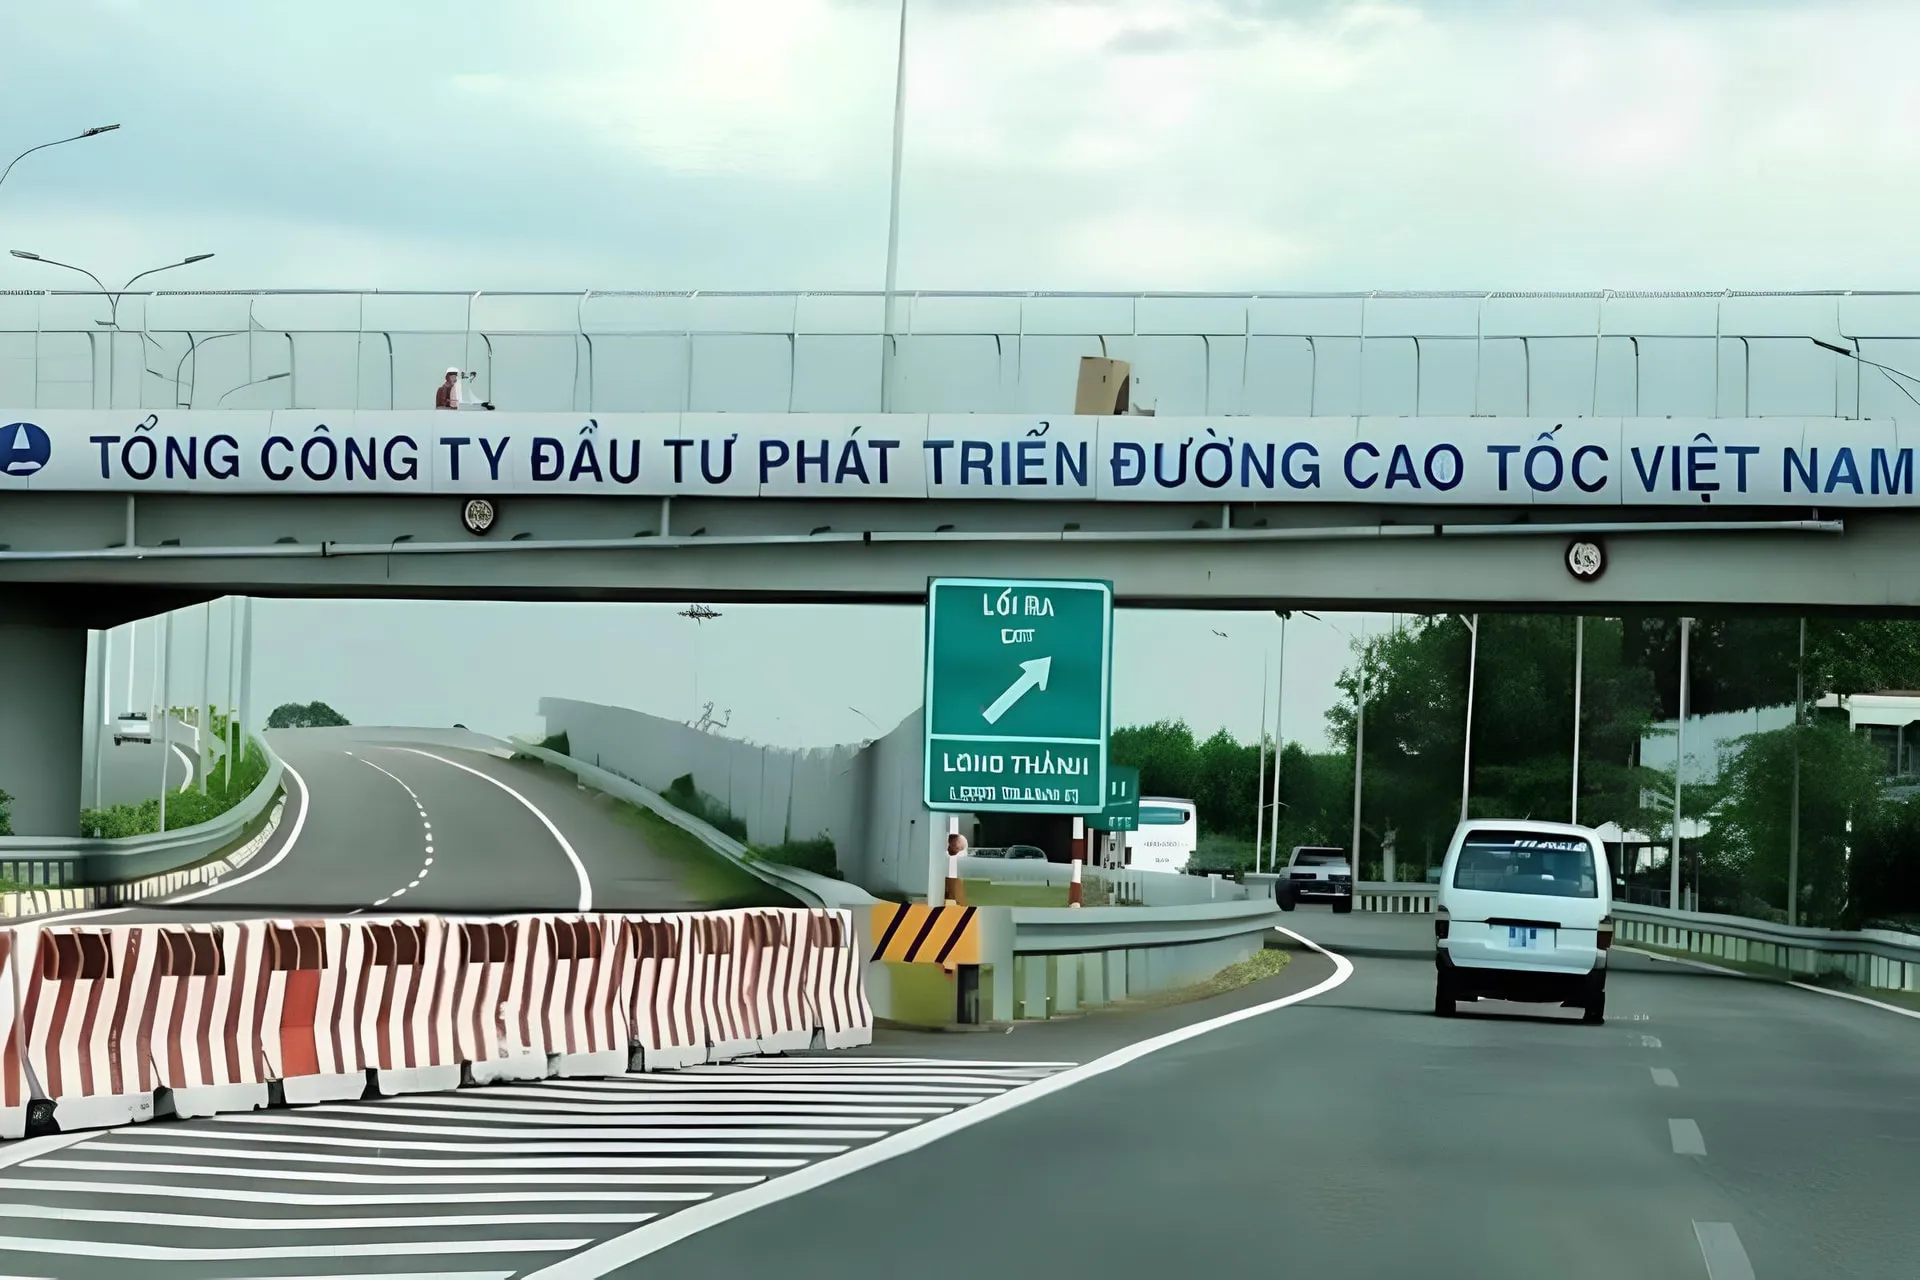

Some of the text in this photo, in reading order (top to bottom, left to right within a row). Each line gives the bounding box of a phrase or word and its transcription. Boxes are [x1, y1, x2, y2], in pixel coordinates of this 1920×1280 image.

[89, 413, 1914, 503] TỔNG CÔNG TY ĐẦU TƯ PHÁT TRIỂN ĐƯỜNG CAO TỐC VIỆT NAM
